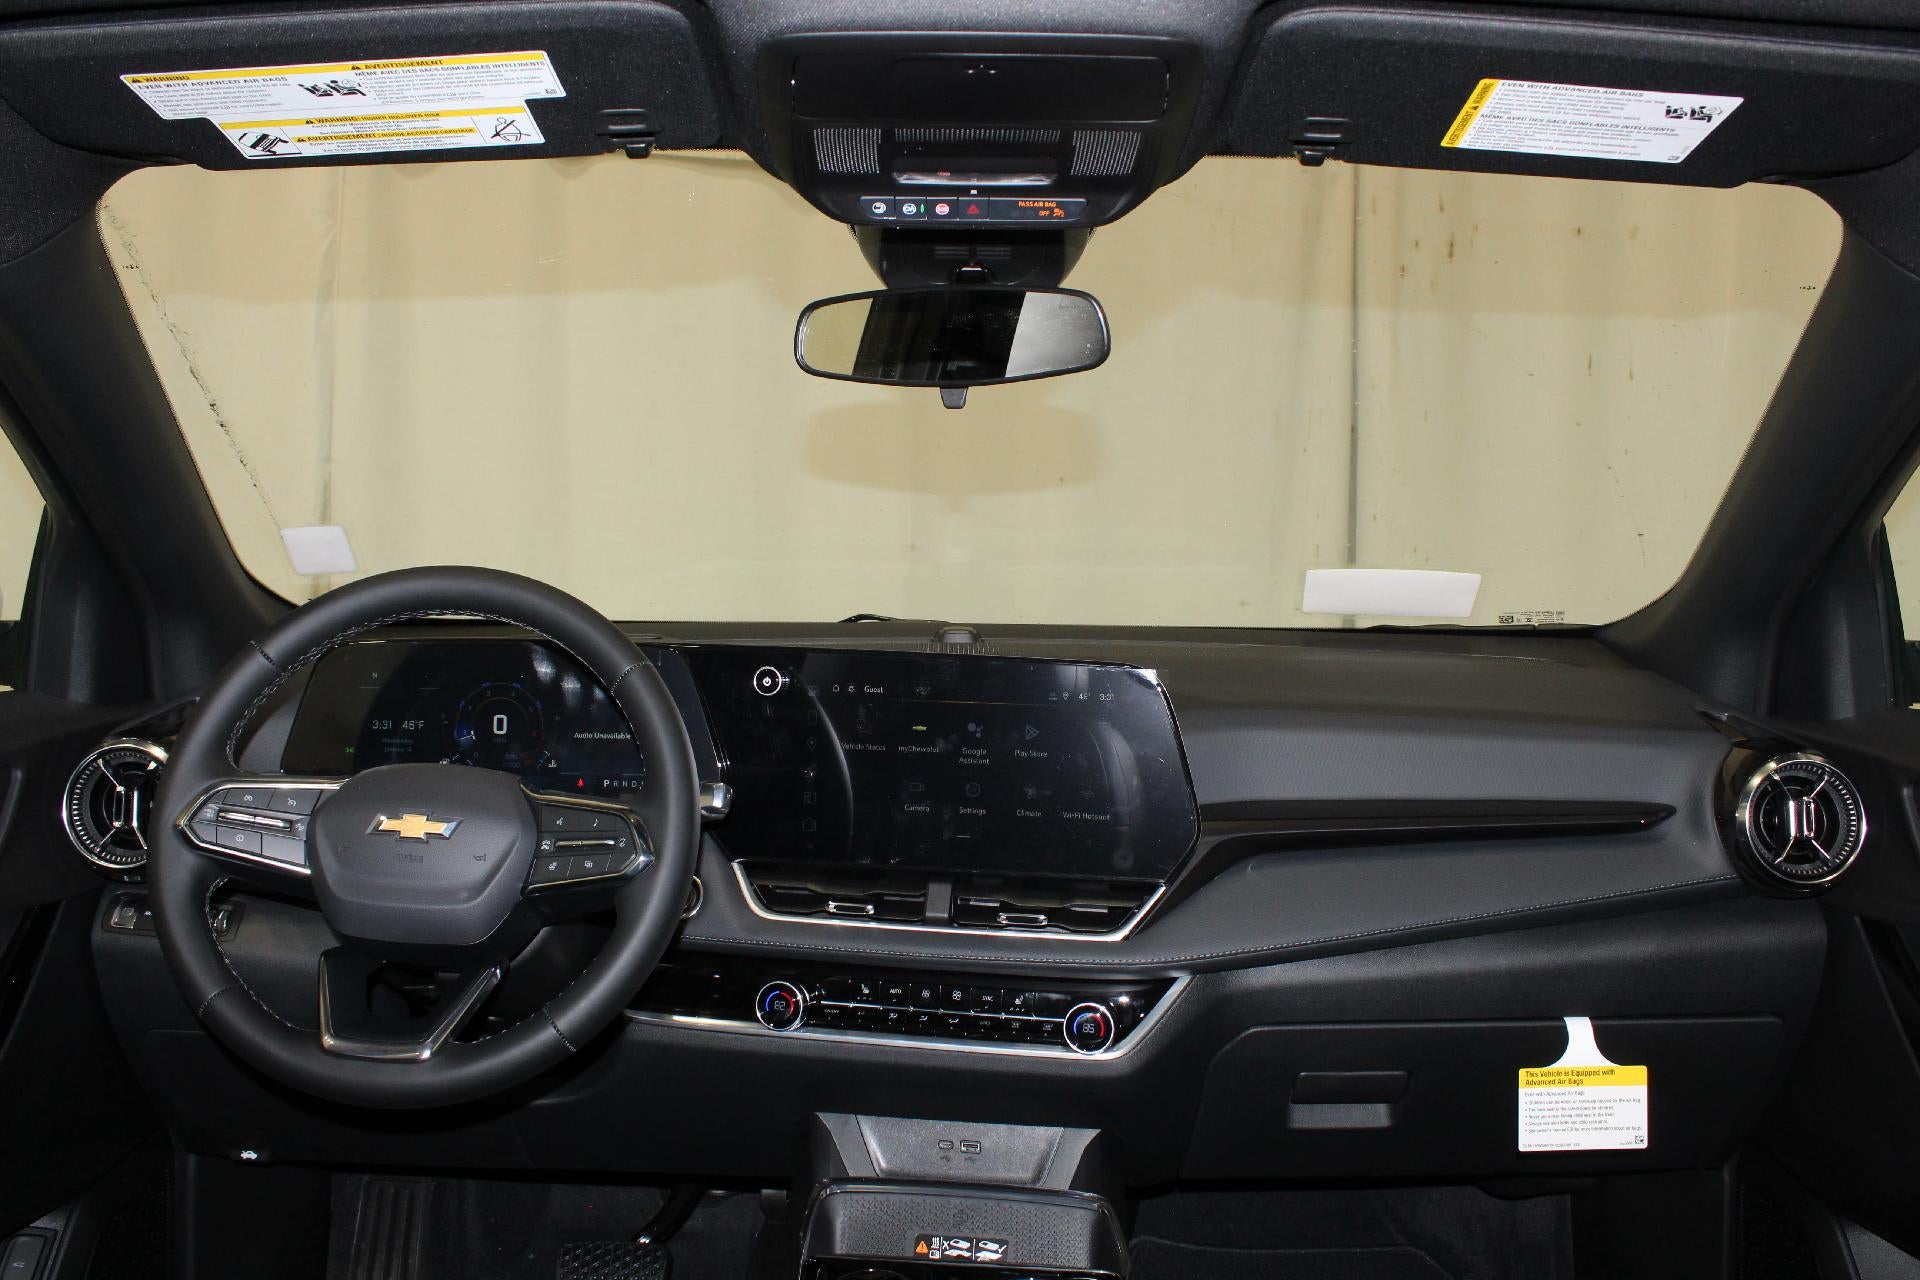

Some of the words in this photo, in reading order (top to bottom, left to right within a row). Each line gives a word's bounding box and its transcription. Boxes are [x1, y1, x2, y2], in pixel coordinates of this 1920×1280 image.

[365, 60, 443, 69] AVERTISSEMENT
[191, 79, 241, 87] ADVANCED
[1552, 85, 1600, 94] ADVANCED
[864, 686, 884, 694] Guest
[372, 720, 392, 729] 3:31
[402, 720, 424, 730] 46°F
[493, 714, 508, 734] 0
[594, 732, 631, 740] Unavailable
[841, 742, 864, 750] Vehicle
[962, 748, 988, 756] Google
[1015, 750, 1028, 758] Play
[959, 757, 990, 766] Assistant
[603, 779, 610, 788] P
[622, 780, 628, 788] N
[631, 780, 638, 788] D
[904, 803, 930, 812] Camera
[959, 806, 987, 816] Settings
[1016, 808, 1042, 817] Climate
[1062, 811, 1081, 819] Wi-Fi
[1082, 812, 1110, 821] Hotspot
[1525, 1070, 1539, 1078] This
[1571, 1069, 1600, 1078] Equipped
[1568, 1078, 1584, 1086] Bags
